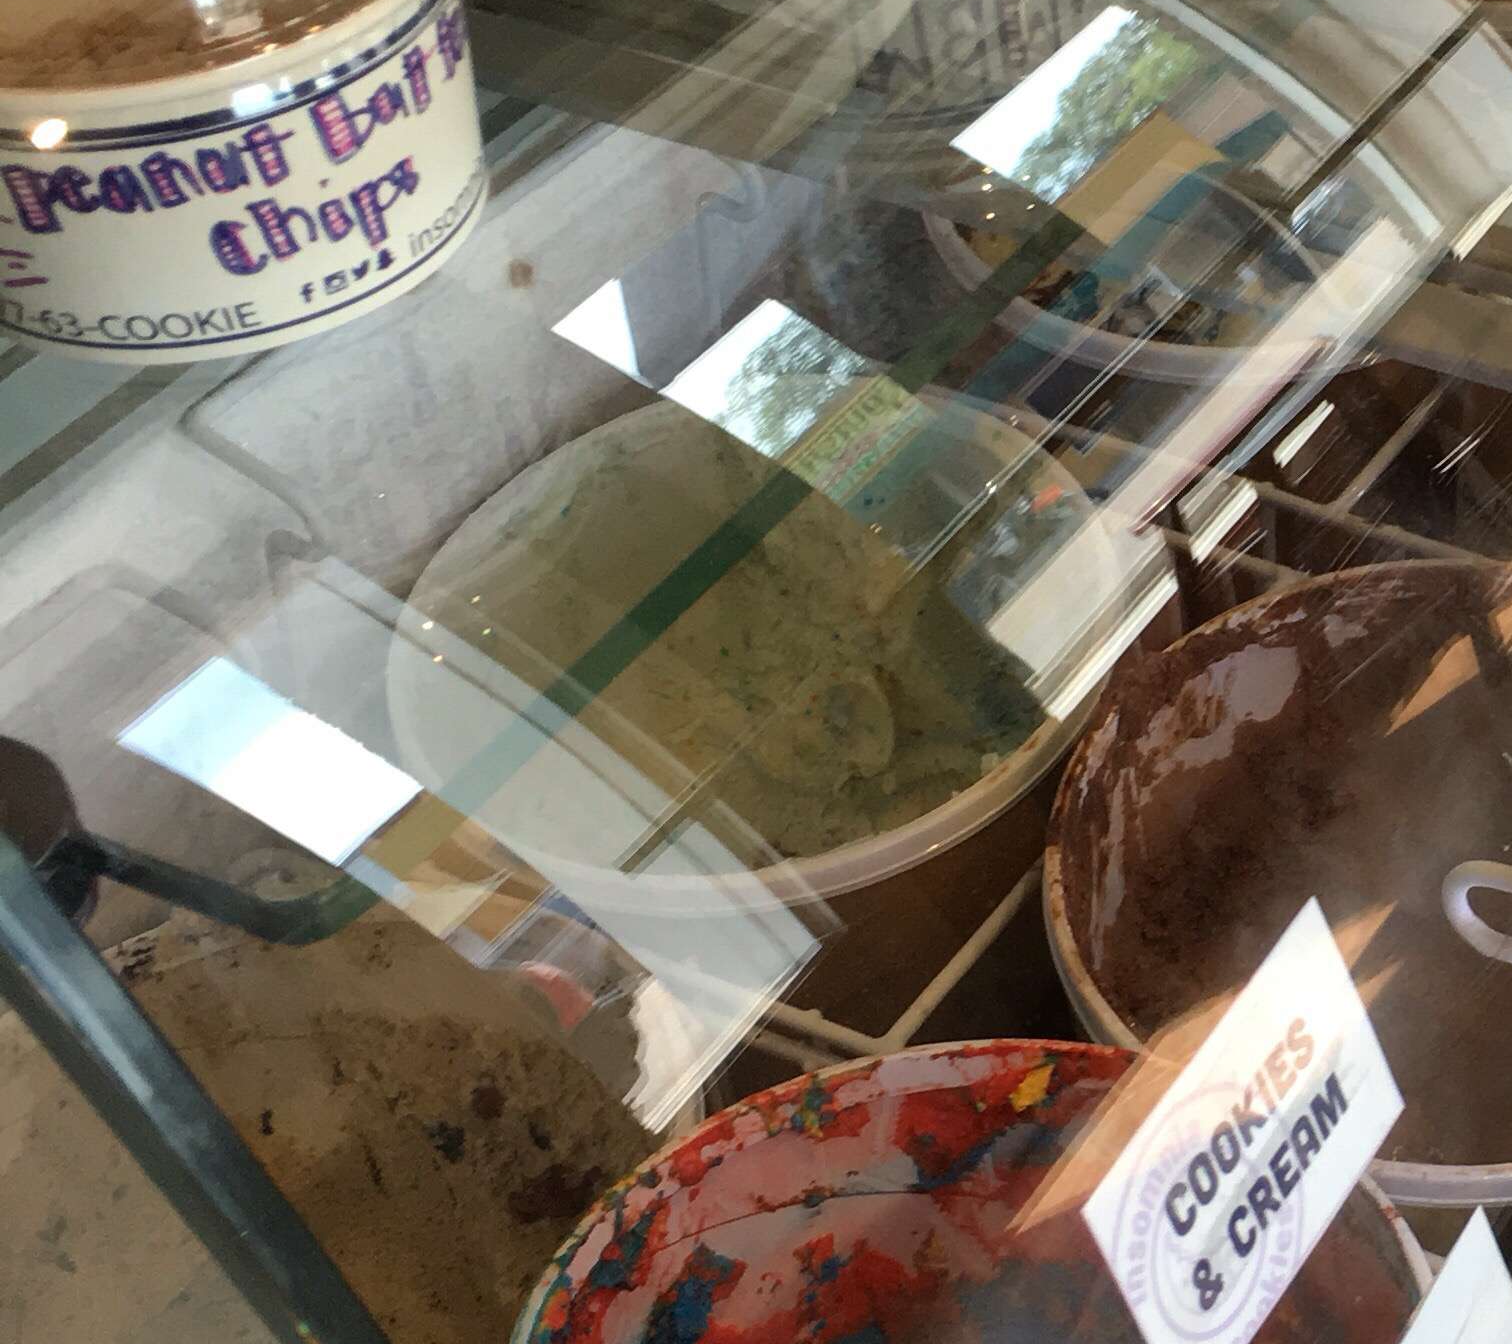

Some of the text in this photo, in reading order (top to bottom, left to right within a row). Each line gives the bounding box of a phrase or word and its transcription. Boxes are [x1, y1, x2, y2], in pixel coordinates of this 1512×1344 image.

[1165, 1016, 1315, 1237] COOKIES
[1192, 1071, 1349, 1311] & CREAM
